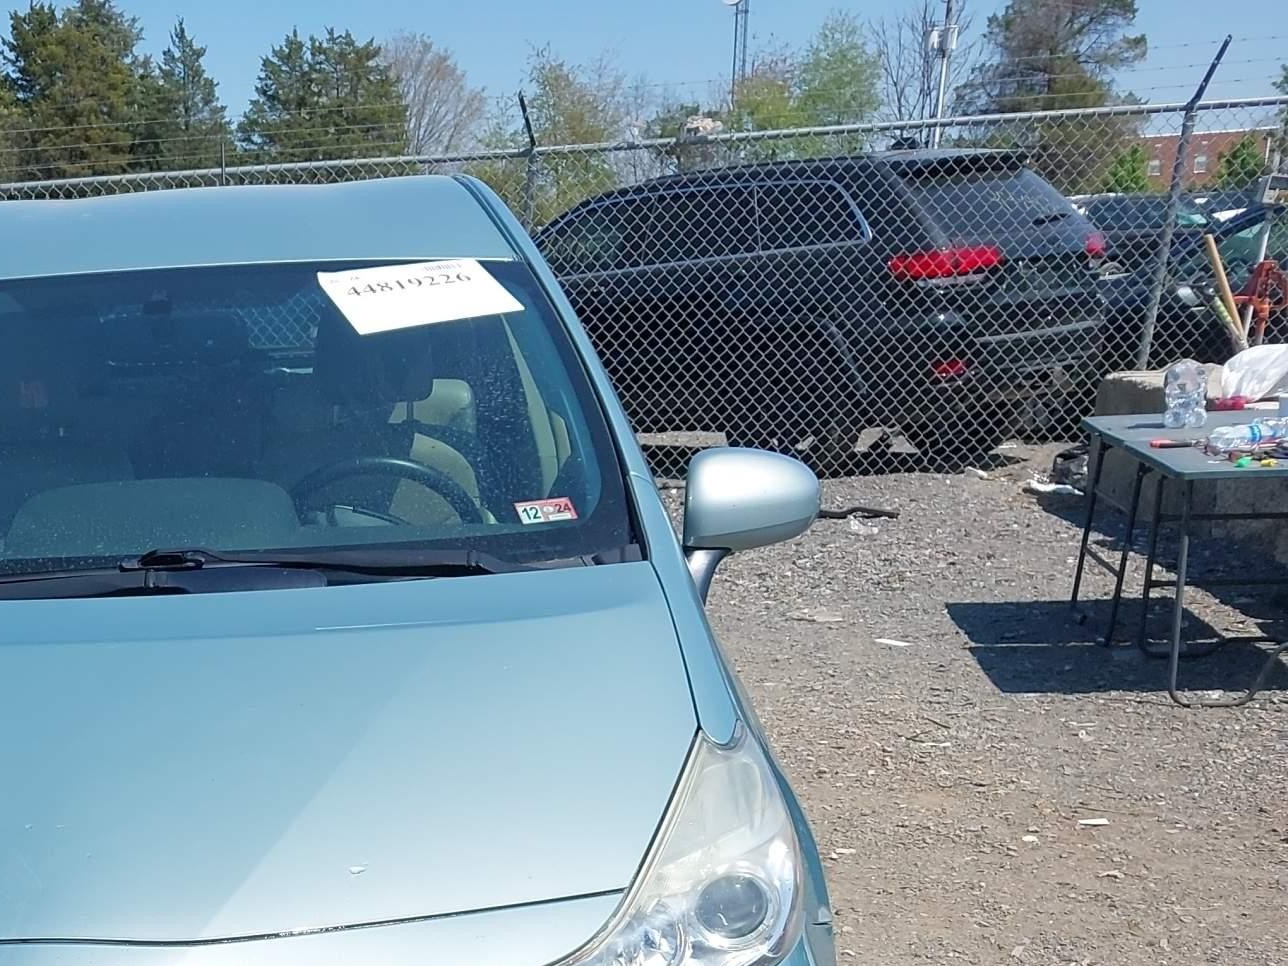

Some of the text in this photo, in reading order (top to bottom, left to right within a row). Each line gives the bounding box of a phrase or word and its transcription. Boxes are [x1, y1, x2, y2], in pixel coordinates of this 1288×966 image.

[347, 272, 472, 297] 44819226
[522, 503, 572, 521] 12 24
